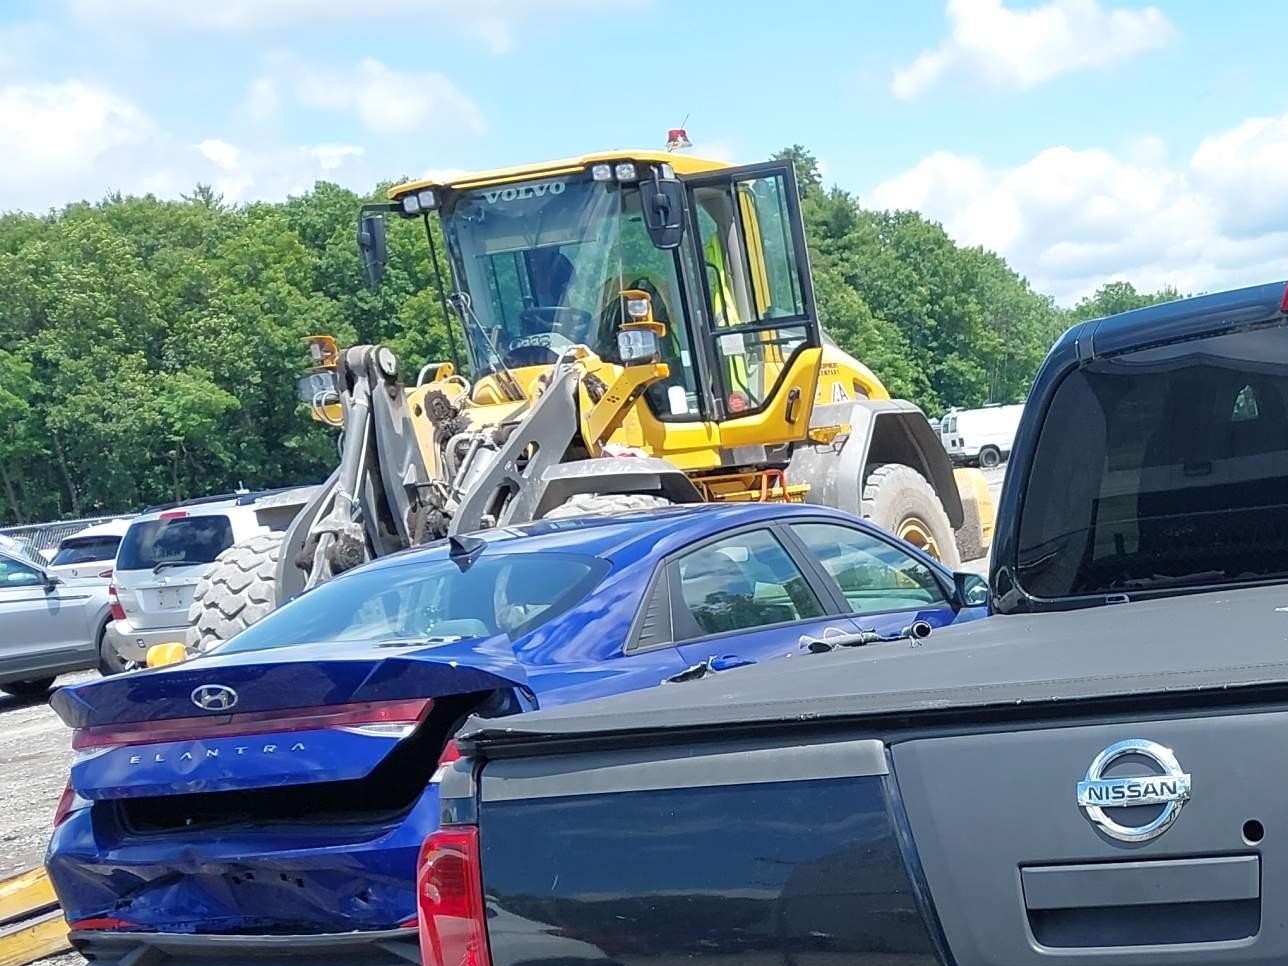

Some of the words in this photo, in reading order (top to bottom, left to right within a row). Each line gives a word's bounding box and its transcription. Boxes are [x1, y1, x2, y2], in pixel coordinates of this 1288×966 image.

[481, 182, 565, 204] VOLVO
[129, 742, 305, 764] ELANTRA
[1088, 781, 1177, 800] NISSAN
